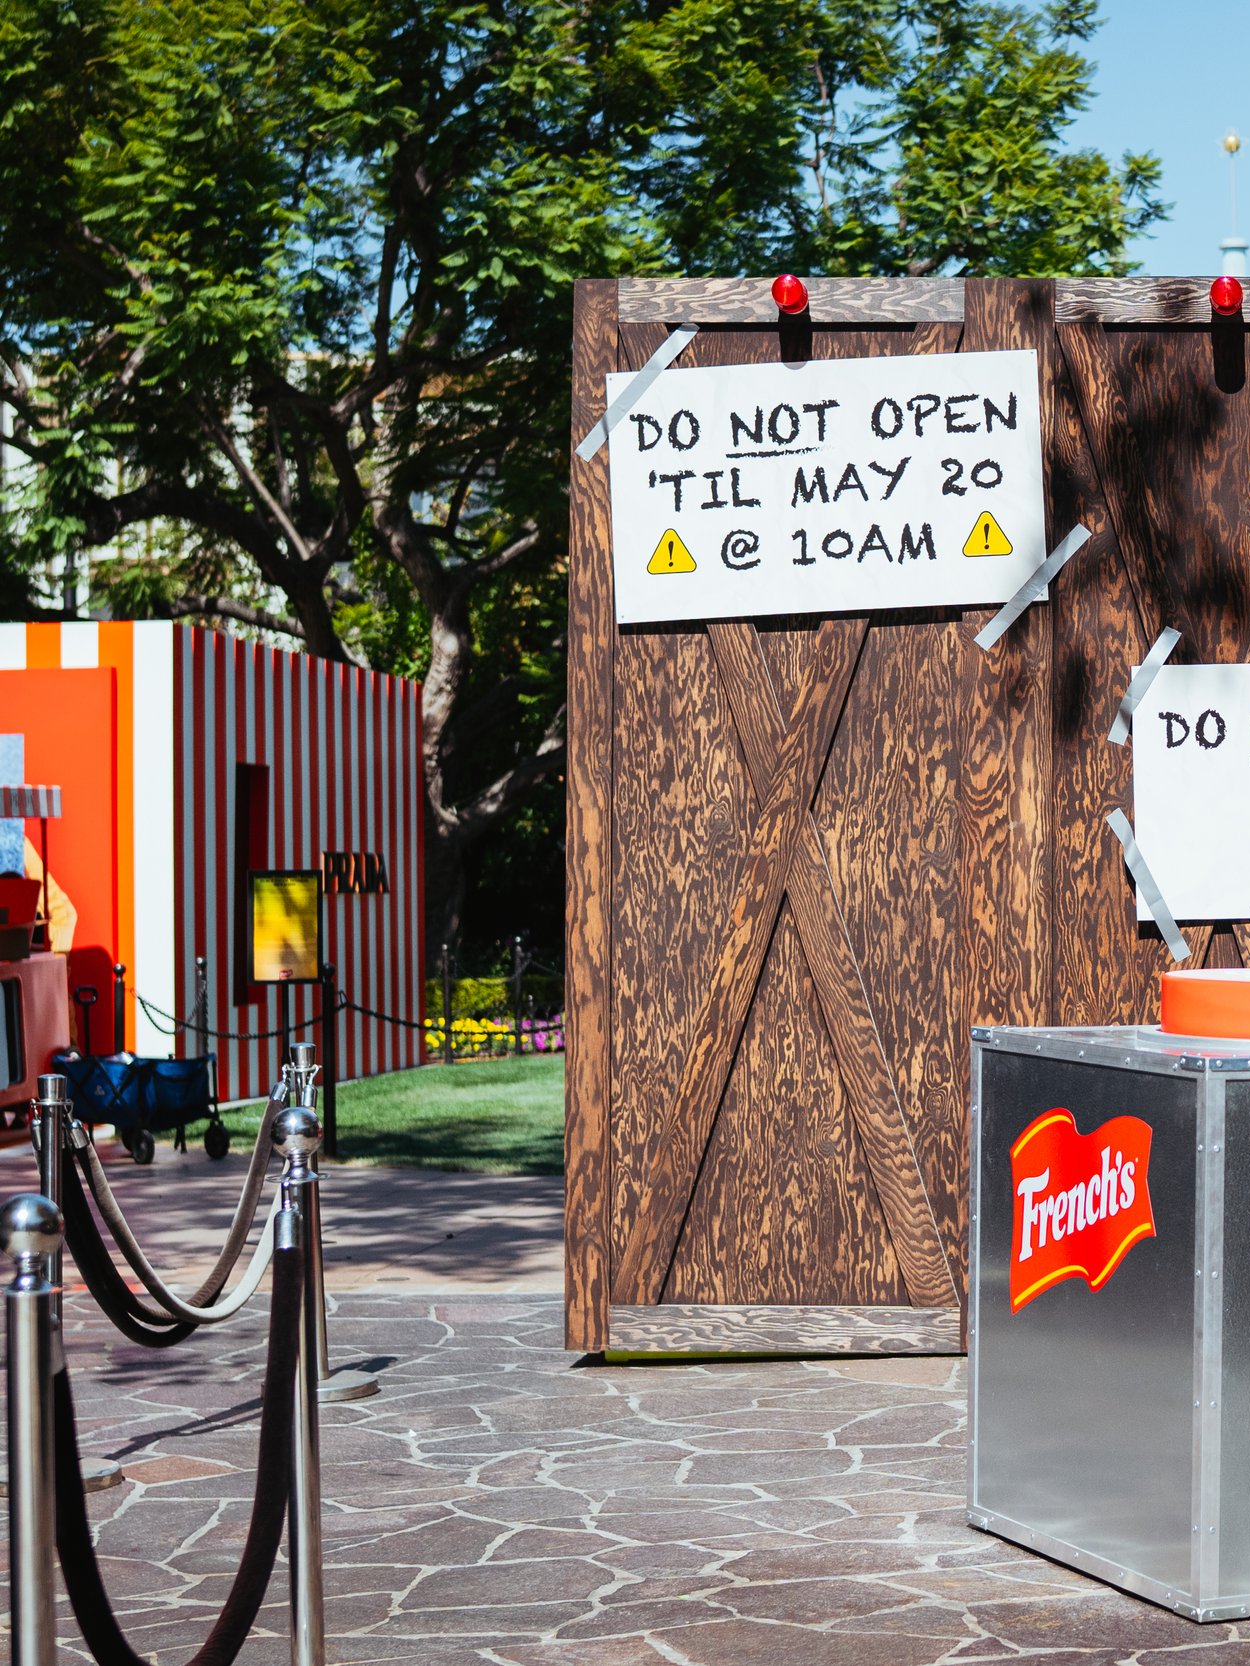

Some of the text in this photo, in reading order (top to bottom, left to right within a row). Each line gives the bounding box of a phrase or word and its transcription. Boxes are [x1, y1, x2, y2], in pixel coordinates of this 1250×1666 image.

[630, 391, 1017, 452] DO NOT OPEN
[648, 456, 1003, 512] 'TIL MAY 20
[720, 522, 937, 571] @ 10AM
[1158, 708, 1226, 750] DO
[322, 852, 390, 894] PRADA
[1016, 1145, 1136, 1263] French's
